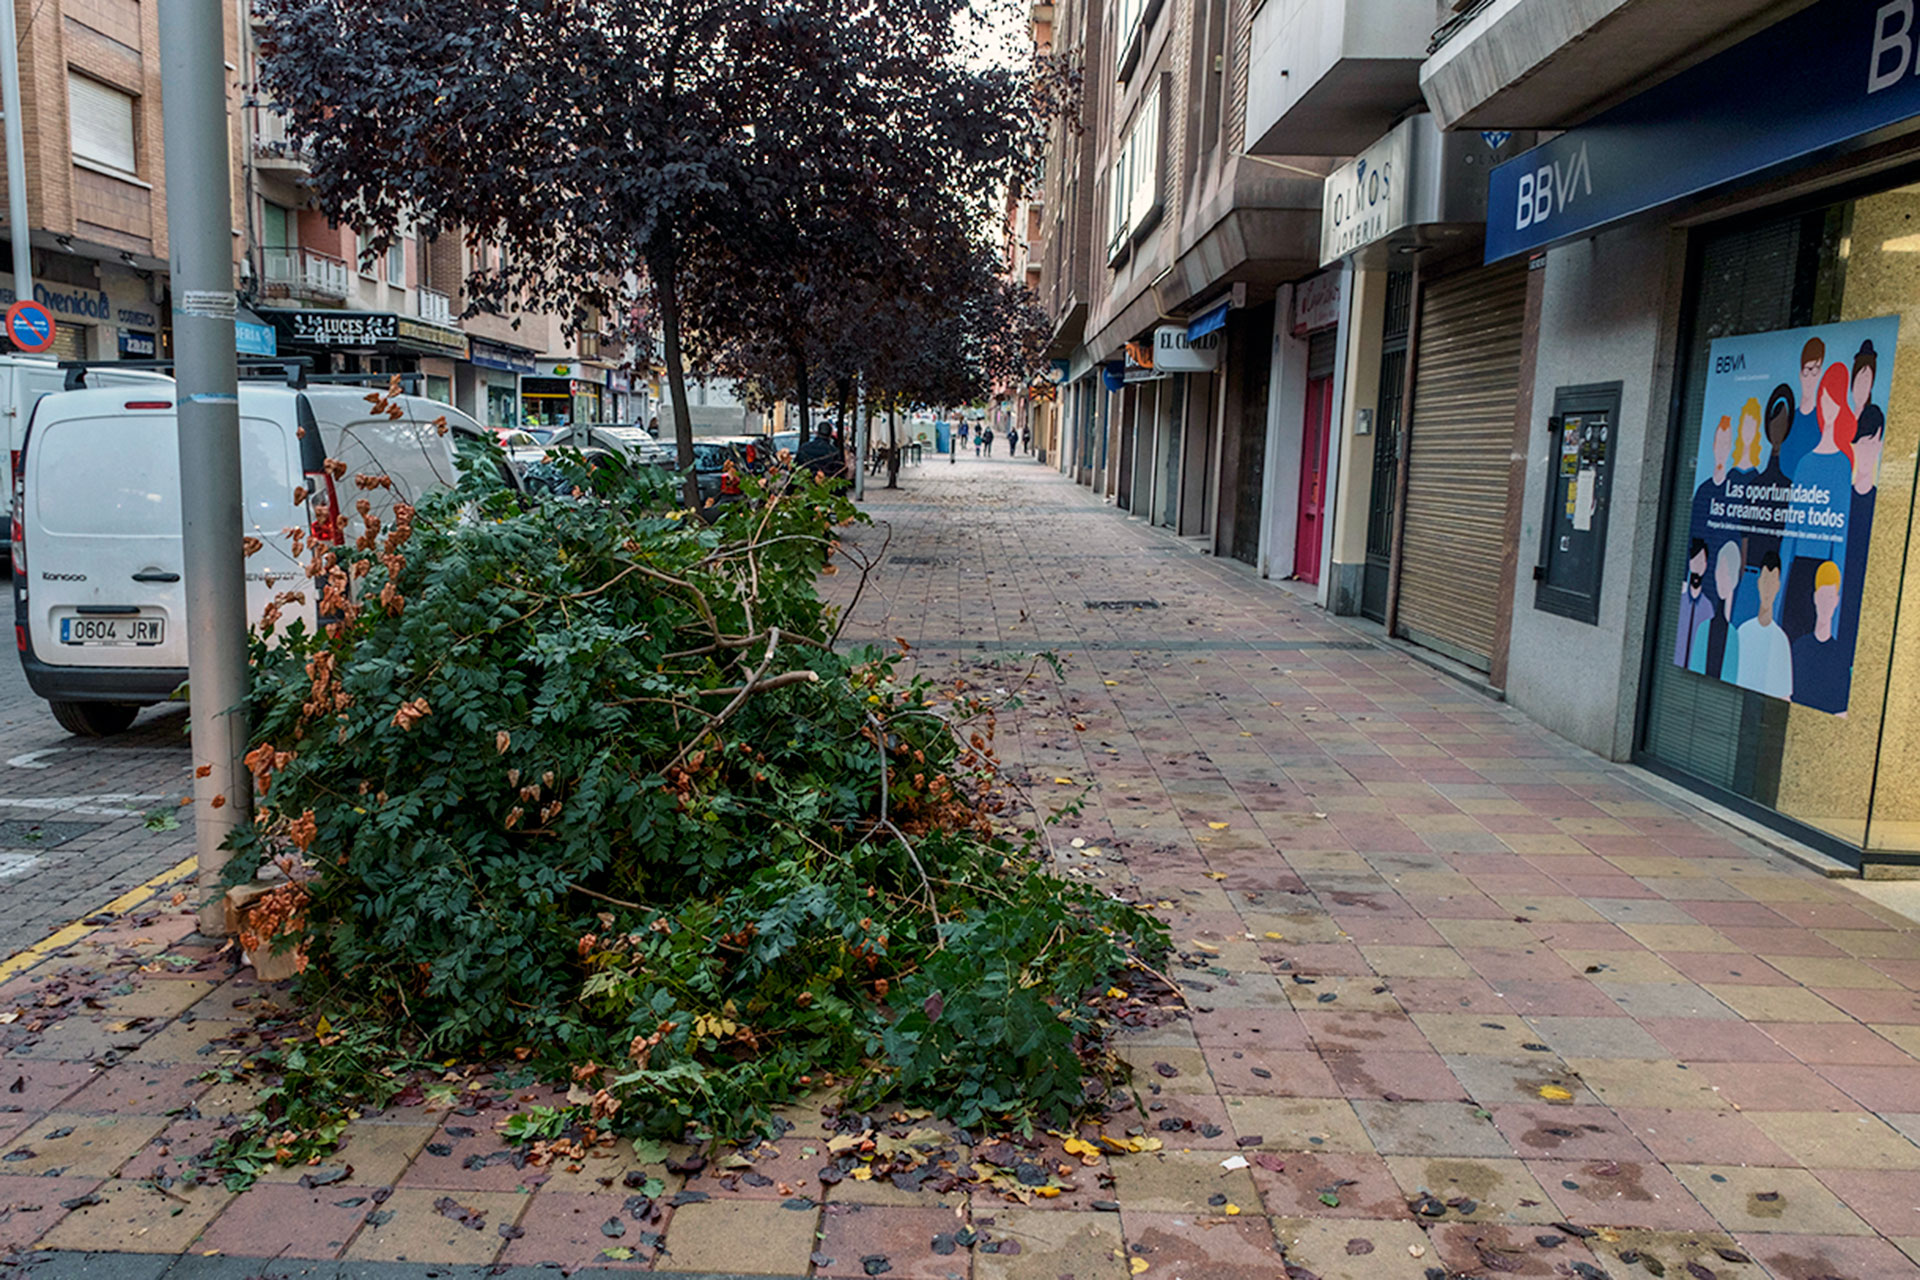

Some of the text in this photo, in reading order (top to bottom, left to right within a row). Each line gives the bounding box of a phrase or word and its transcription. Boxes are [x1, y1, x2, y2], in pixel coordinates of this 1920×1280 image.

[1867, 0, 1920, 94] B
[1464, 152, 1513, 166] OLM
[1334, 161, 1391, 227] OLMOS
[1516, 140, 1592, 231] BBVA
[235, 326, 261, 342] DERIA
[324, 319, 364, 334] LUCES
[1160, 332, 1218, 350] EL CHOLLO
[1716, 353, 1746, 374] BBVA
[1725, 480, 1830, 505] Las oportunidades
[1709, 498, 1845, 528] las creamos entre todos
[42, 571, 87, 582] Kangoo
[75, 621, 159, 639] 0604 JRW
